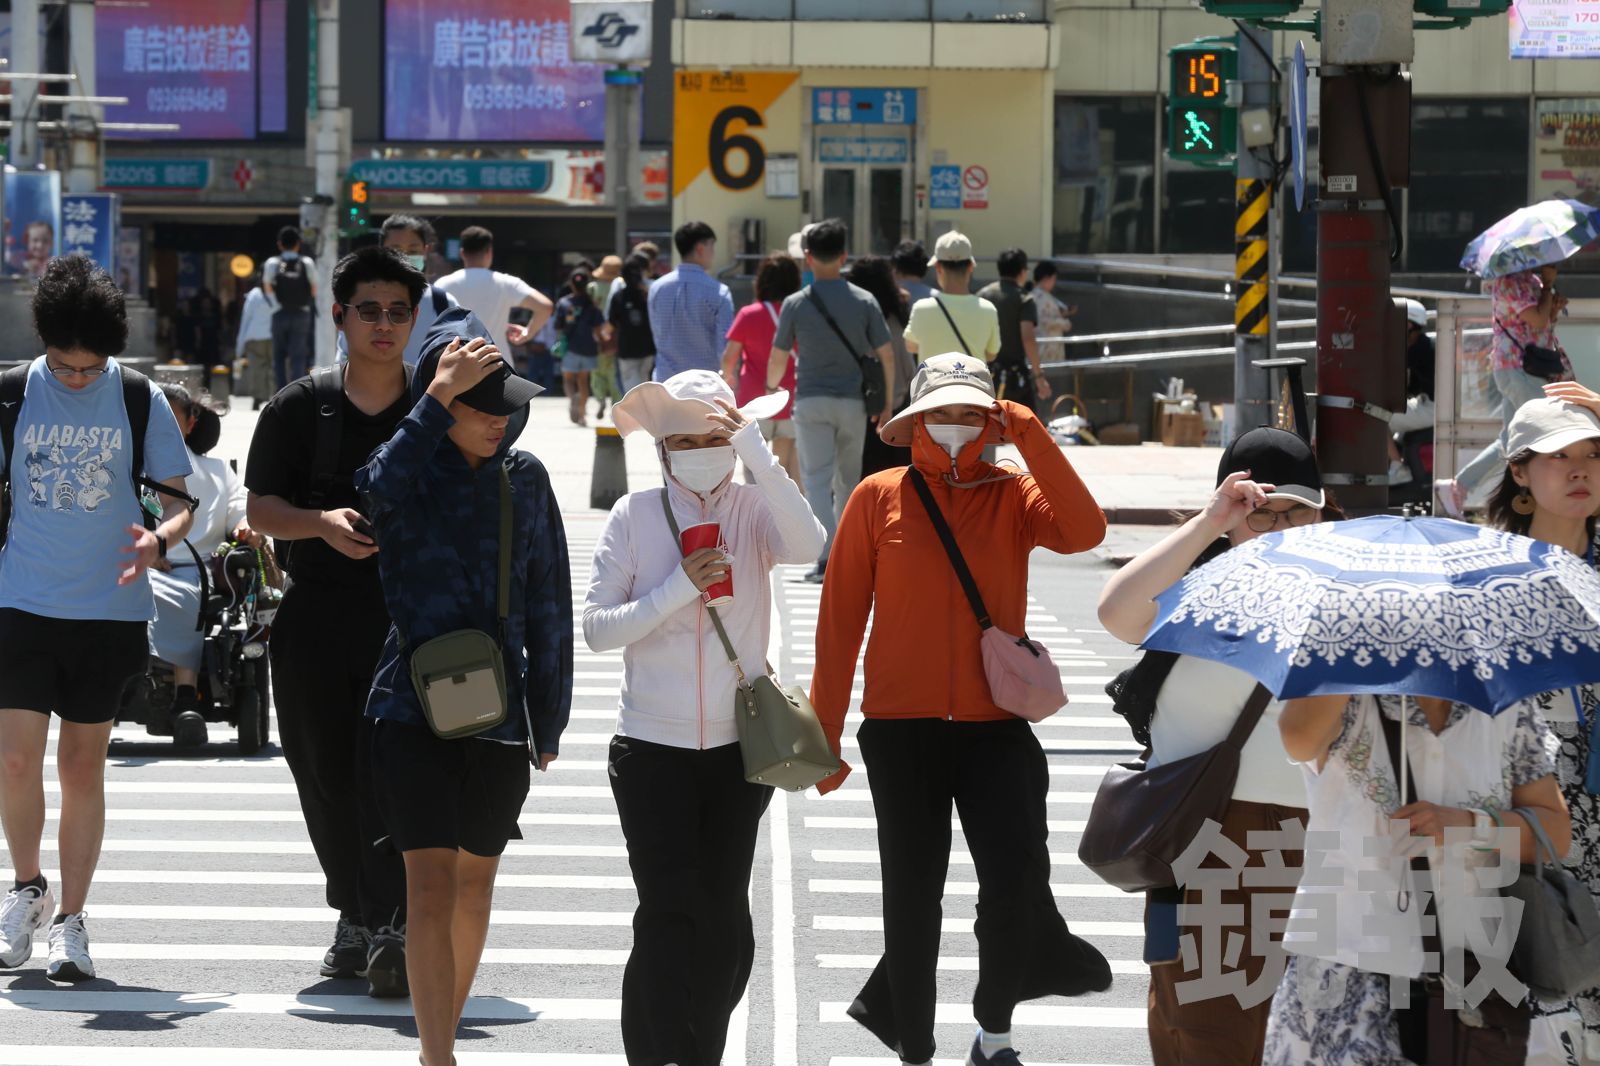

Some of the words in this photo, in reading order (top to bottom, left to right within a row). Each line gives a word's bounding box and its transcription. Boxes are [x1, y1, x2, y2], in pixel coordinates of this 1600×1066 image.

[123, 25, 252, 72] 廣告投放請洽
[433, 18, 597, 68] 廣告投放請
[1189, 54, 1220, 97] 15
[708, 104, 766, 190] 6
[360, 165, 468, 185] watsons
[23, 423, 122, 450] ALABASTA
